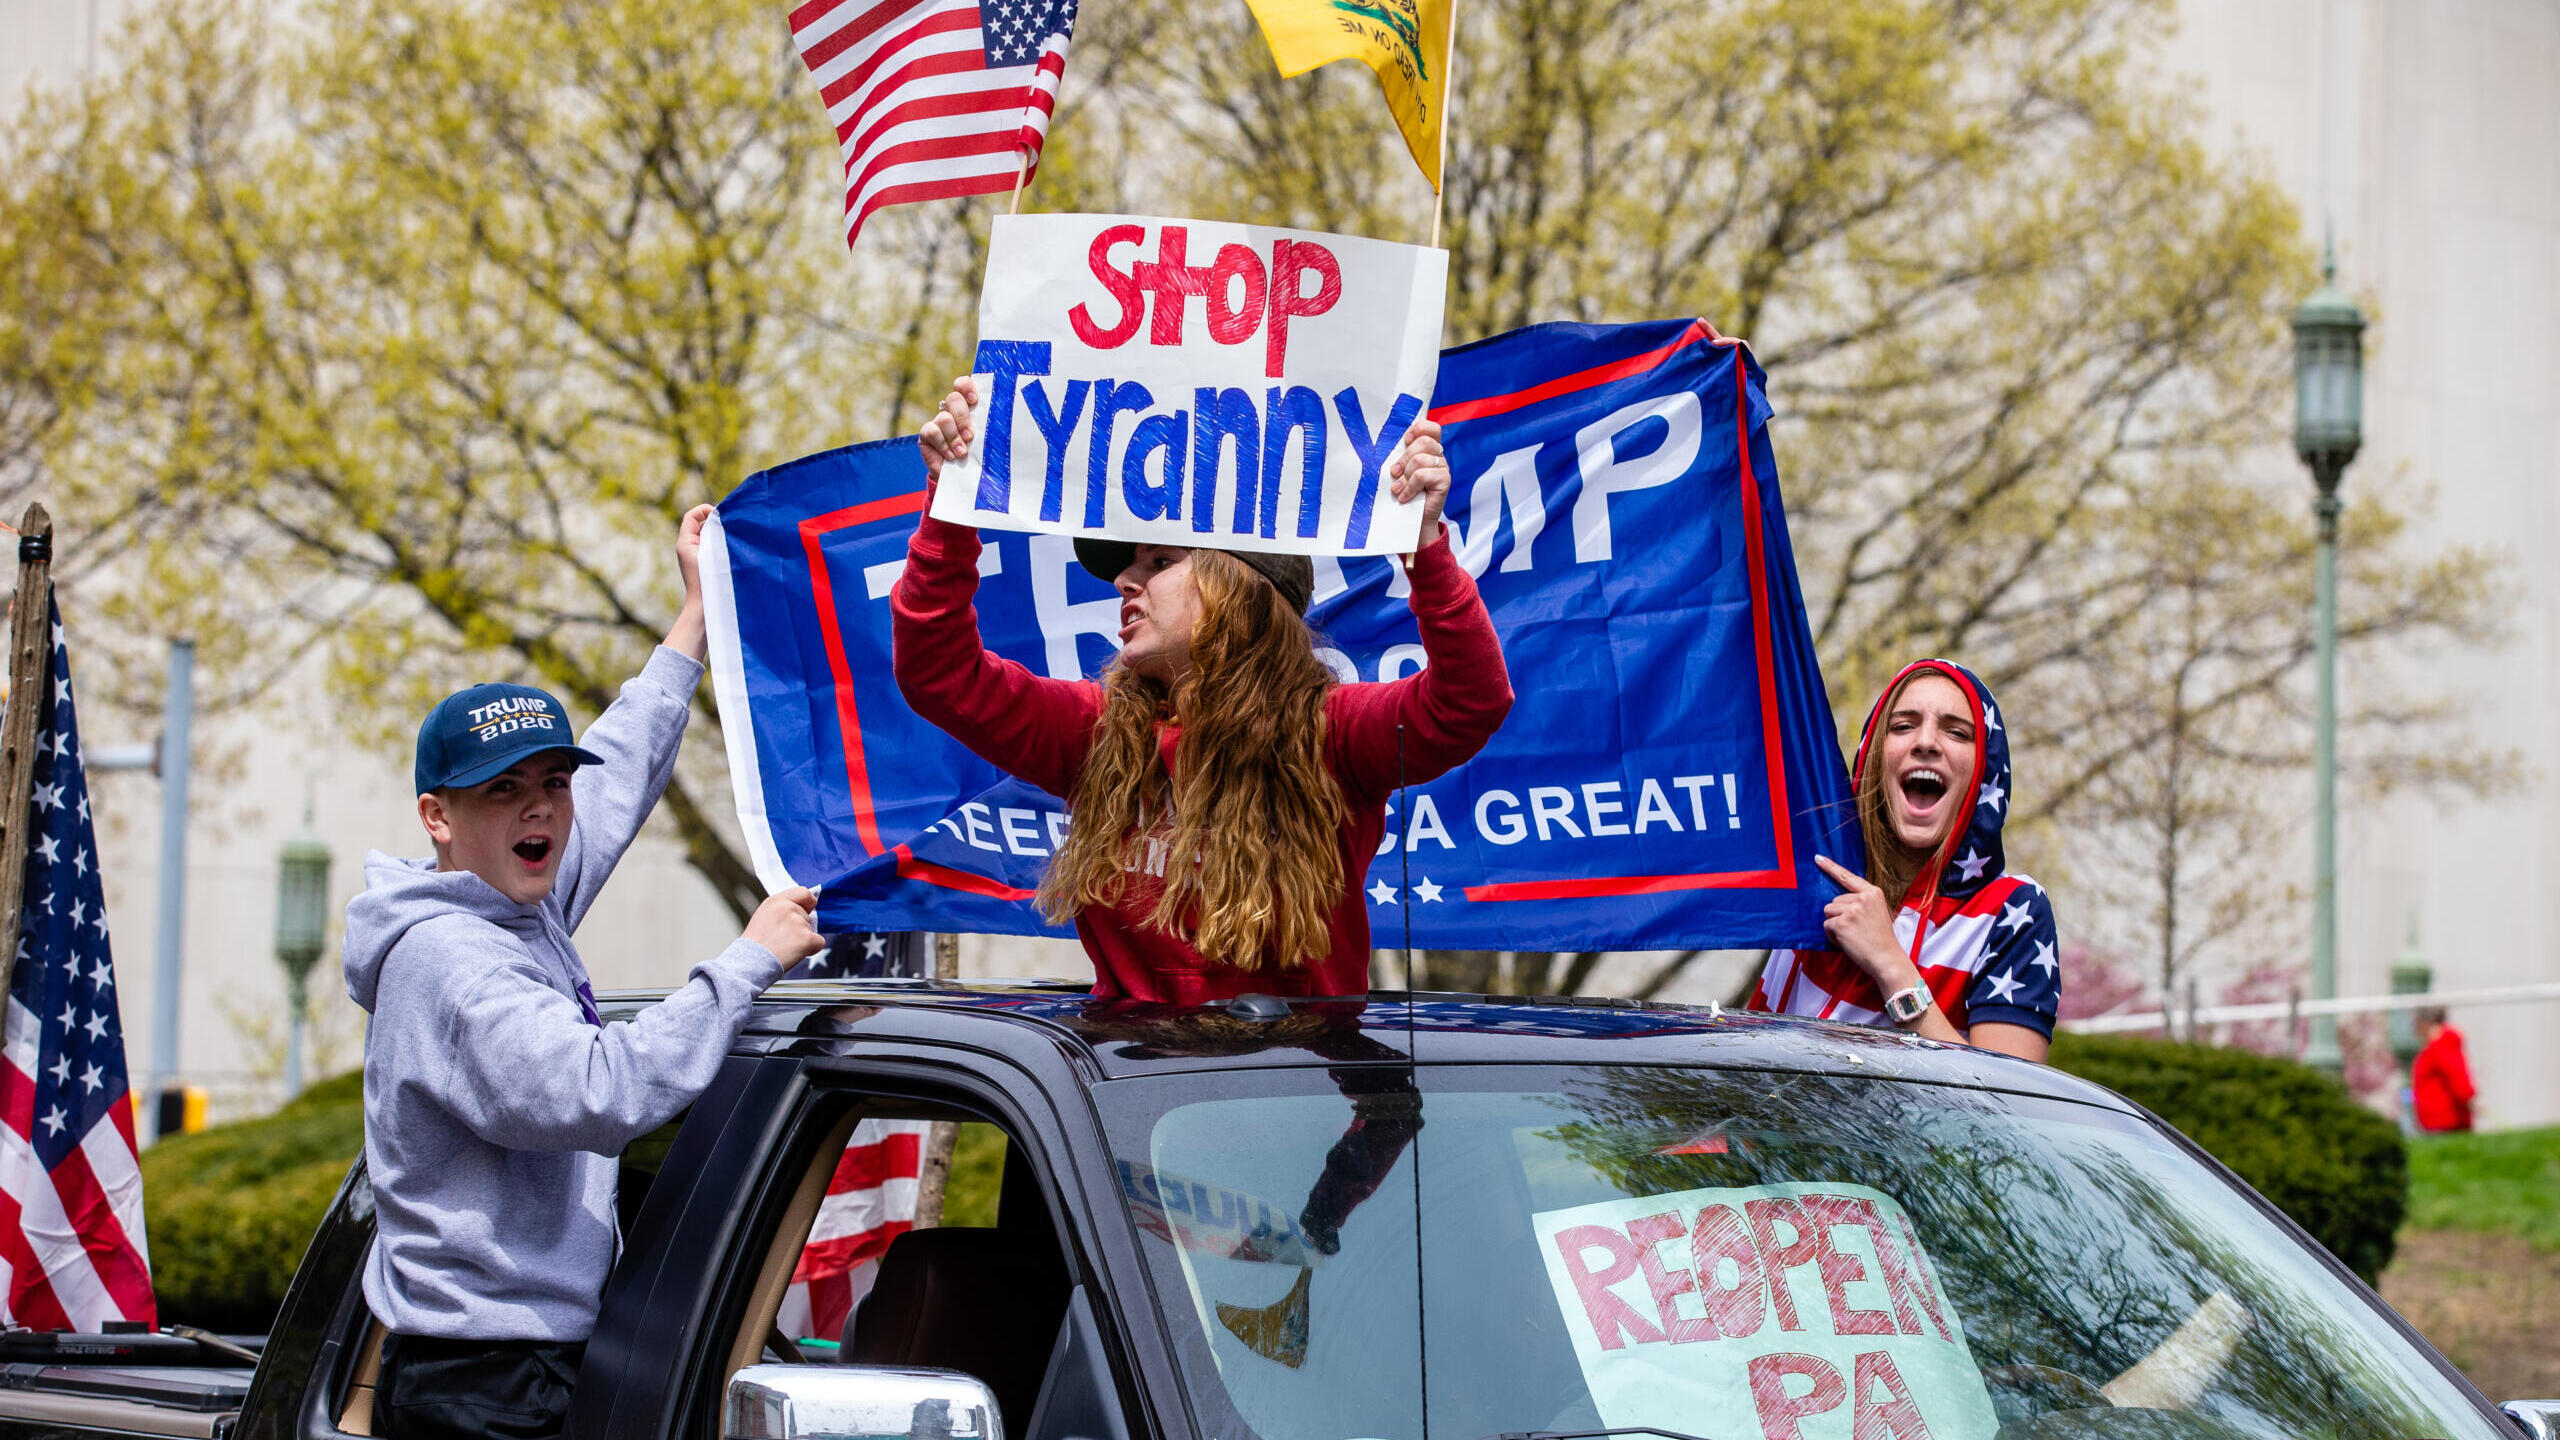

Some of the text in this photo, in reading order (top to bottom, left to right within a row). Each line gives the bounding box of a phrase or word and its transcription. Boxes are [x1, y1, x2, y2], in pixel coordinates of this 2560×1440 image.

[973, 340, 1423, 550] Tyranny
[863, 391, 1702, 681] RMP
[468, 697, 547, 724] TRUMP
[480, 716, 554, 742] 2020
[1474, 773, 1741, 846] GREAT!
[1554, 1193, 1955, 1351] REOPEN
[1747, 1350, 1937, 1440] PA
